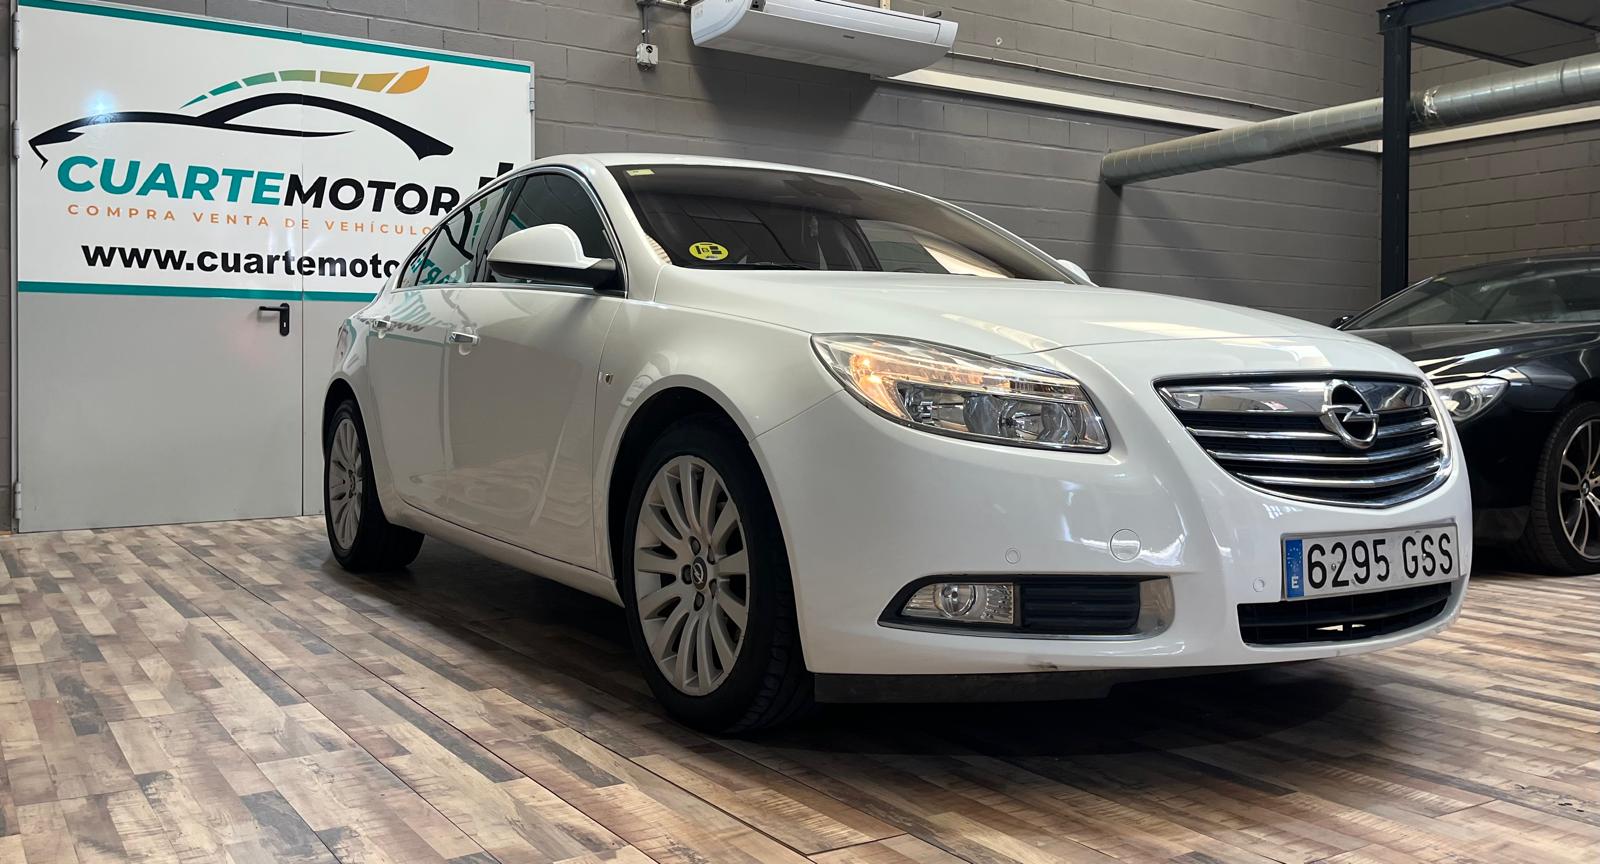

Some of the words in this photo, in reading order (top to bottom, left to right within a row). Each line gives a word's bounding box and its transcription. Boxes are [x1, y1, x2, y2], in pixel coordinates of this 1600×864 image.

[68, 204, 175, 220] COMPRA
[193, 213, 269, 227] VENTA
[286, 218, 309, 229] DE
[1307, 539, 1390, 589] 6295
[1402, 533, 1452, 578] GSS
